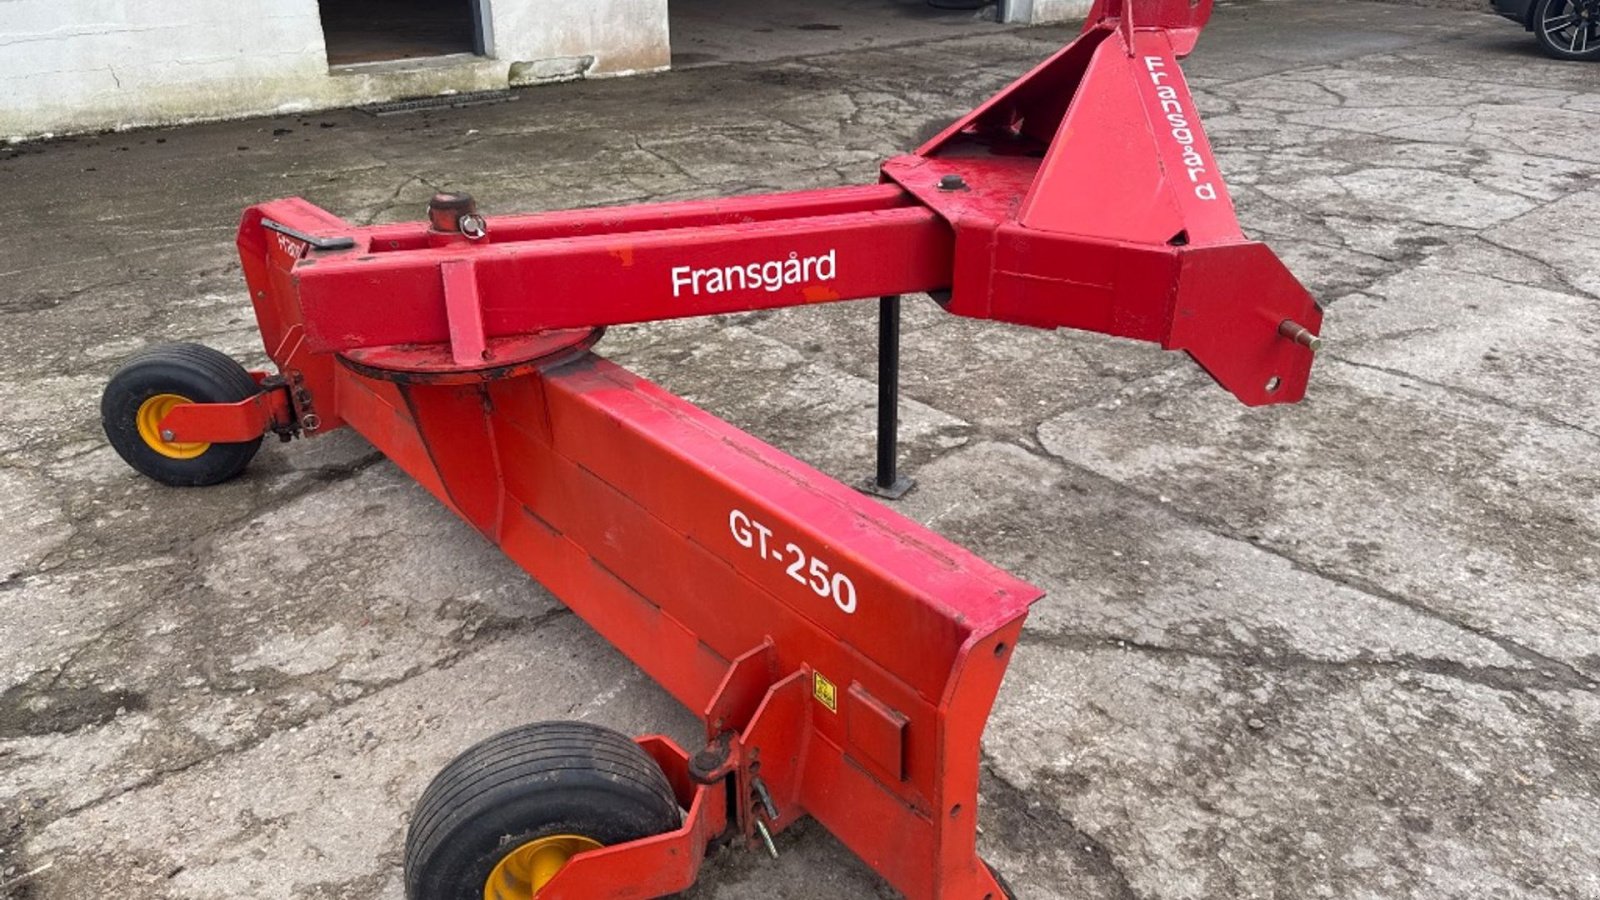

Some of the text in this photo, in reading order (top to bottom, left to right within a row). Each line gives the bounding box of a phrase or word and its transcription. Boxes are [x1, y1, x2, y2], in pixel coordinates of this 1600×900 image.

[1144, 56, 1217, 200] Fransgård
[671, 249, 837, 297] Fransgård
[729, 509, 857, 614] GT-250
